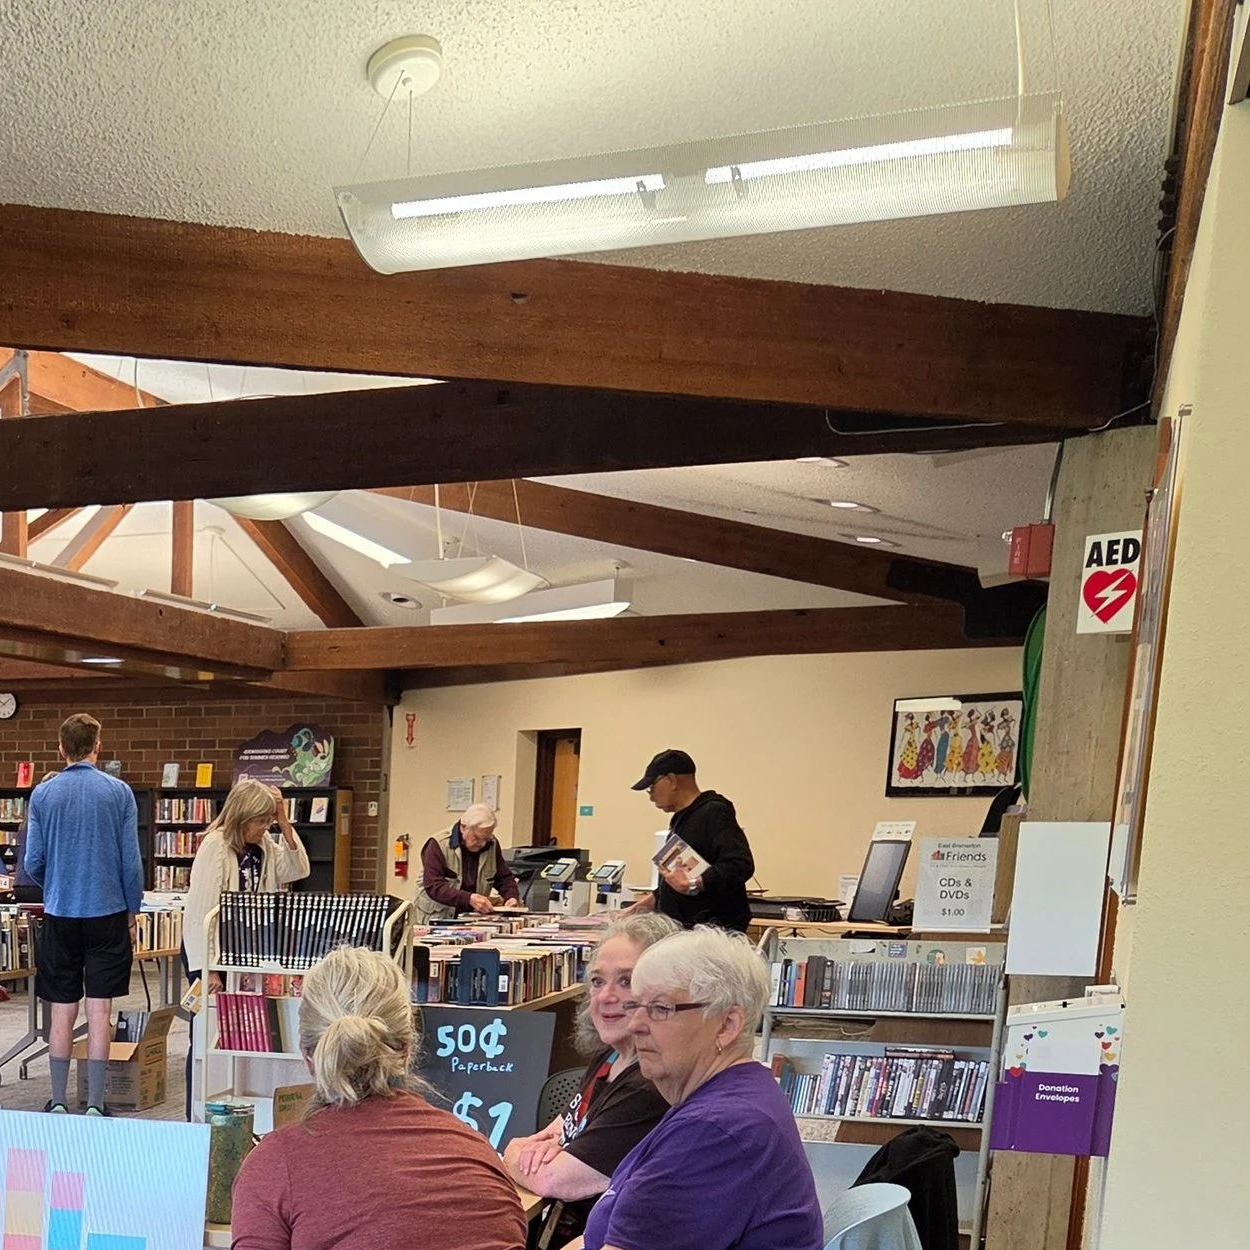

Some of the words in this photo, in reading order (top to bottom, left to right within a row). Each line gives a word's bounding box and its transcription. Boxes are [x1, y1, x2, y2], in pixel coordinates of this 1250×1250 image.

[1085, 537, 1141, 569] AED
[946, 851, 987, 862] Friends
[939, 878, 962, 887] CDs
[964, 878, 972, 887] &
[939, 889, 970, 900] DVDs
[941, 907, 965, 917] $1.00
[436, 1018, 508, 1059] 50¢
[451, 1057, 515, 1075] Paperback
[1038, 1083, 1079, 1094] Donation
[1035, 1092, 1080, 1103] Envelopes
[452, 1091, 513, 1151] $1
